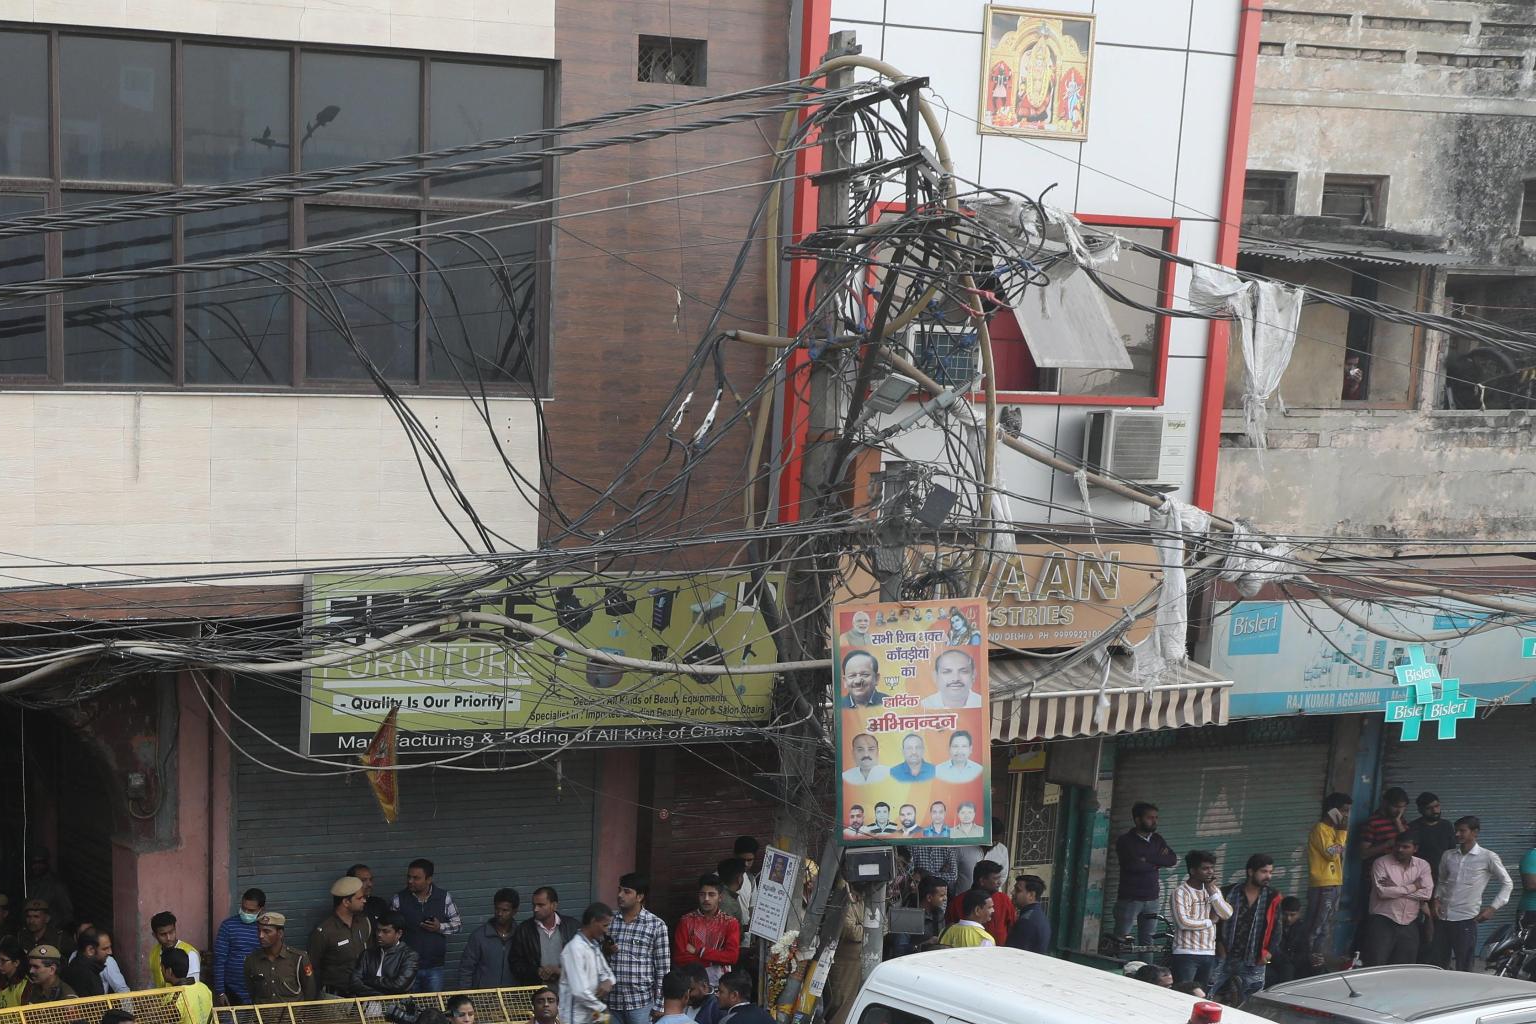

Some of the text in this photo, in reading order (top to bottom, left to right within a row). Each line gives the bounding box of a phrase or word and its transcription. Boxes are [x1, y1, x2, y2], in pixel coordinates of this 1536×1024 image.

[1232, 611, 1278, 637] Bisleri
[872, 631, 893, 645] सभी
[896, 630, 916, 643] शिव
[323, 641, 534, 679] FURNITURE
[901, 666, 916, 678] का
[1405, 664, 1435, 684] Bisleri
[351, 693, 505, 712] Quality Is Our Priority
[883, 694, 919, 708] हार्दिक
[1286, 695, 1304, 710] RAJ
[1306, 693, 1335, 709] KUMAR
[1337, 691, 1381, 707] AGGARWAL
[1430, 697, 1468, 718] Bisleri
[1394, 703, 1423, 719] Bisle
[867, 713, 956, 732] अभिनन्दन
[338, 732, 475, 750] Mafacturing
[481, 732, 494, 745] &
[595, 728, 618, 742] All
[624, 727, 662, 742] Kind
[669, 725, 684, 739] of
